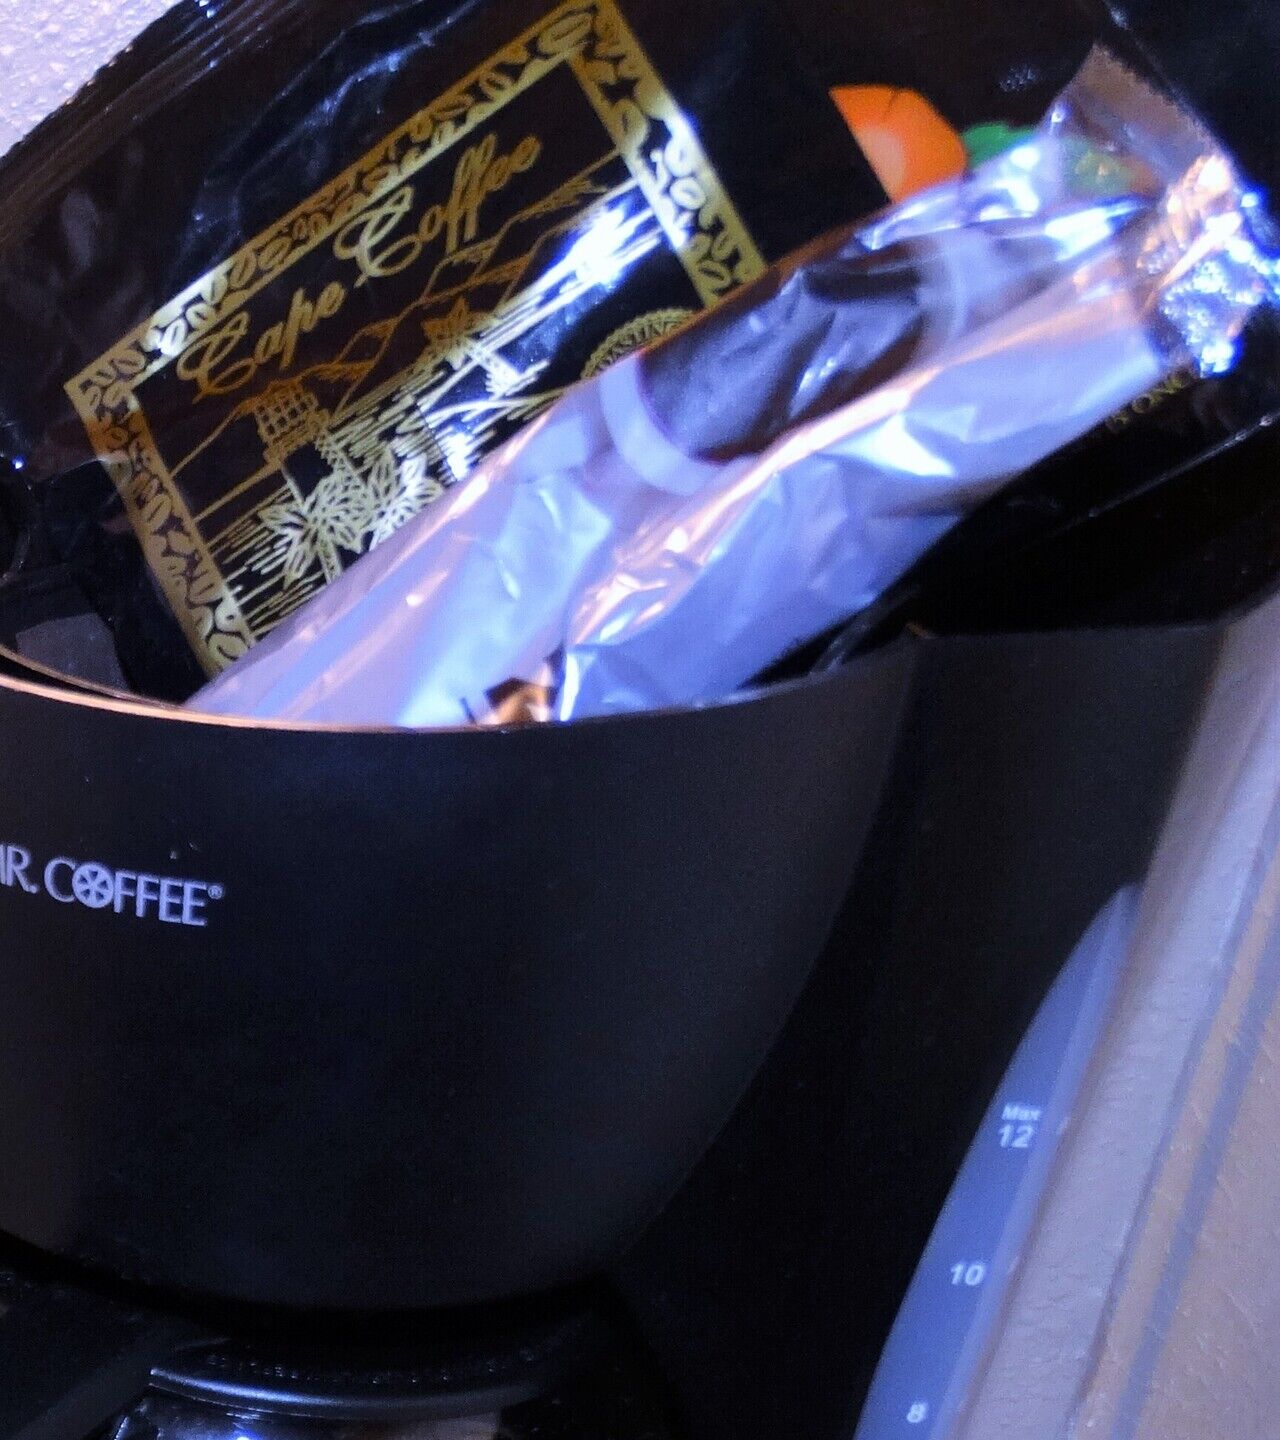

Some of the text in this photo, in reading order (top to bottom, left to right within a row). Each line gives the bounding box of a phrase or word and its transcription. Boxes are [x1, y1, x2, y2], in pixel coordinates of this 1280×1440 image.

[176, 133, 541, 404] Cape Coffee
[998, 1124, 1034, 1149] 12
[950, 1262, 986, 1287] 10
[906, 1402, 928, 1424] 8
